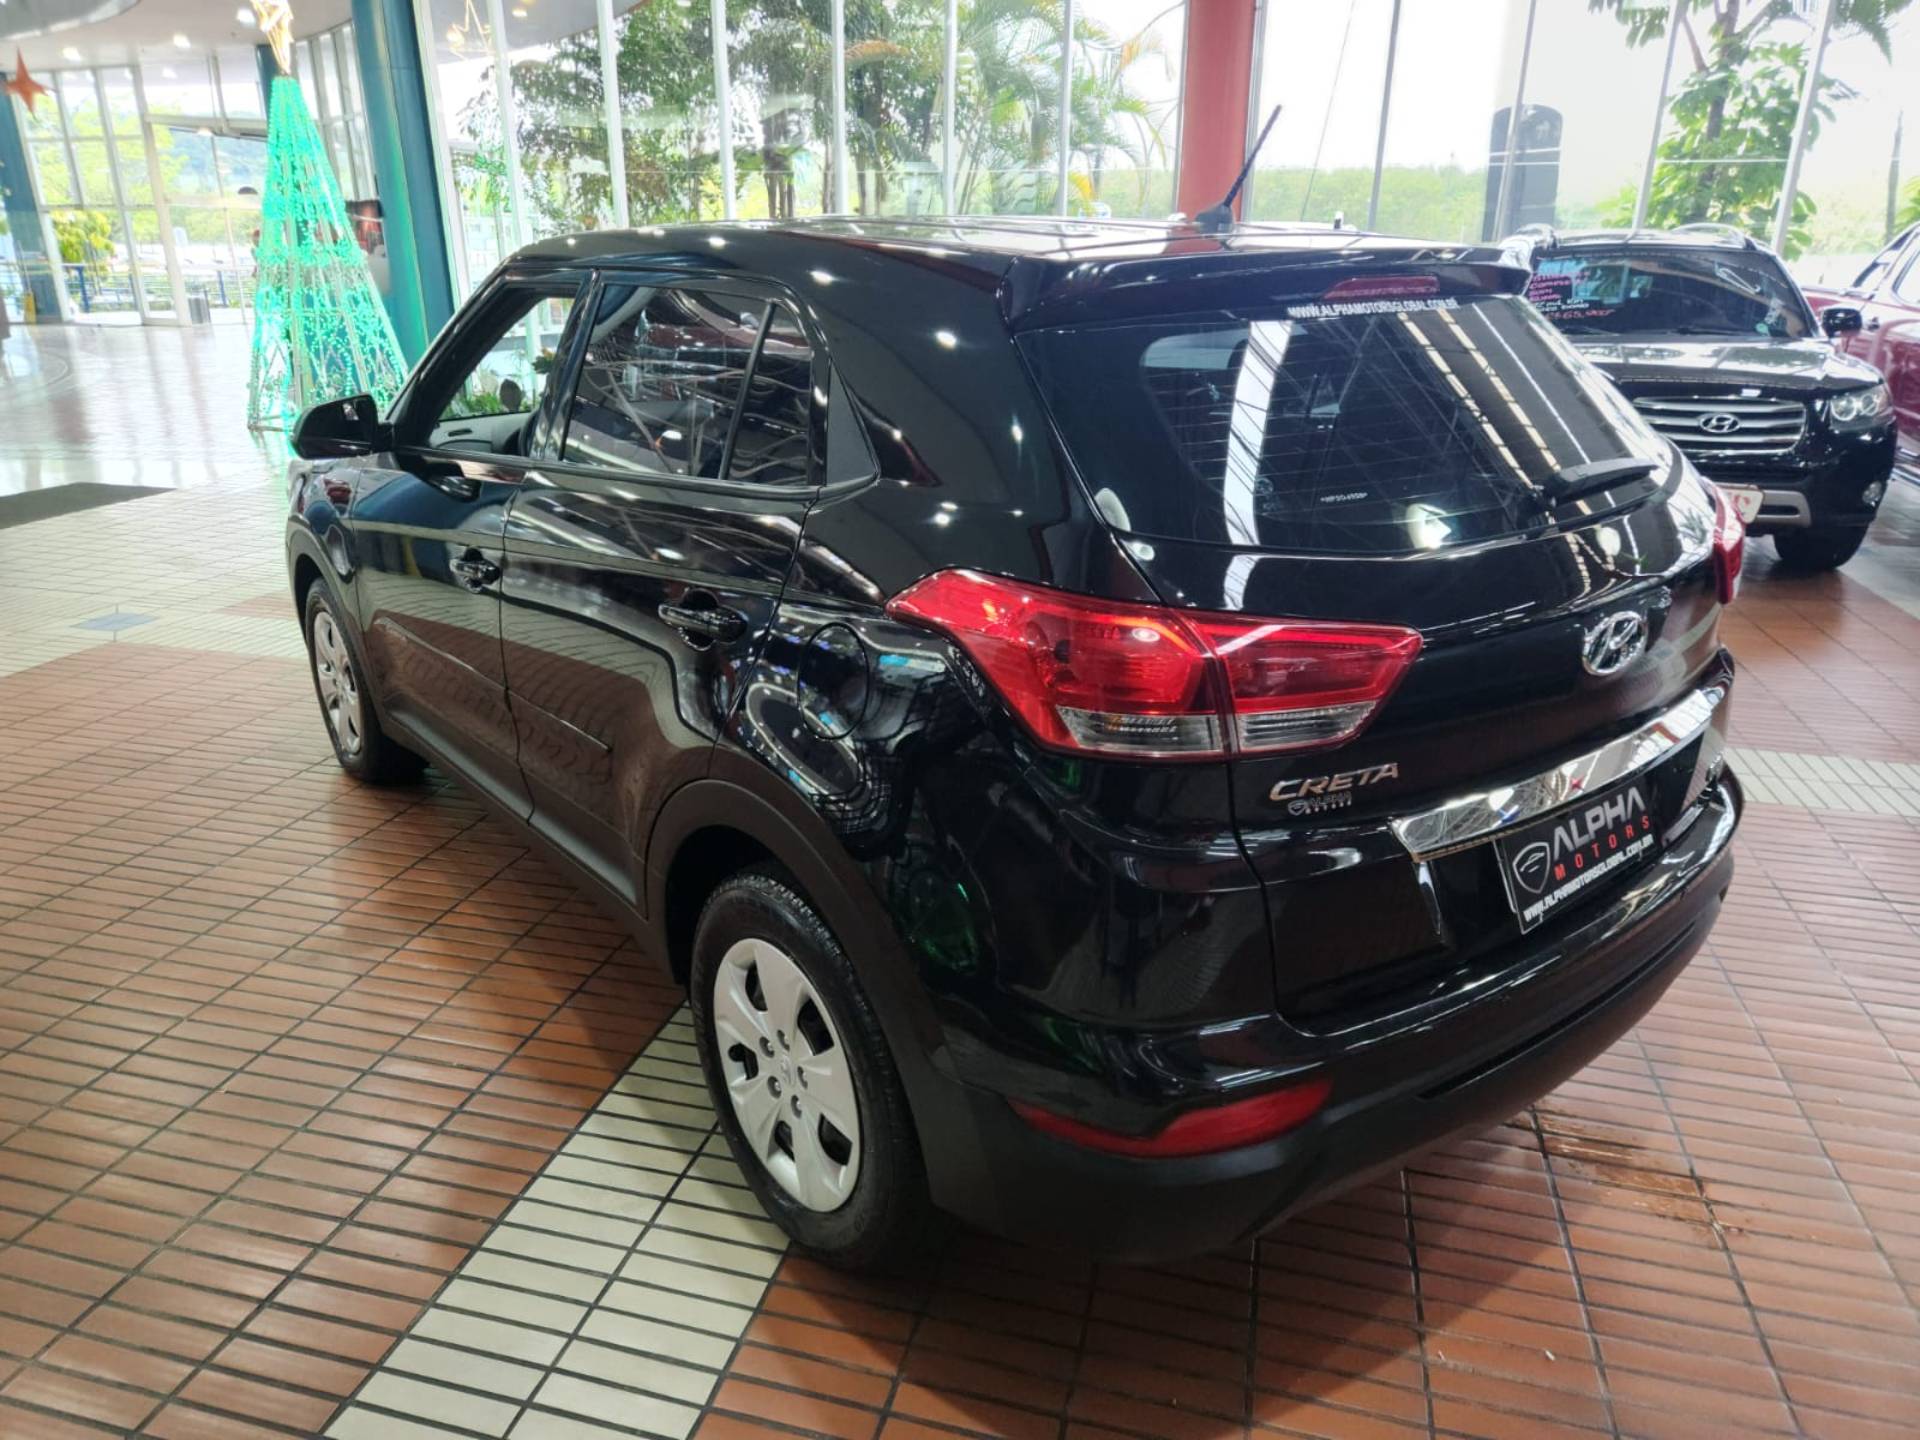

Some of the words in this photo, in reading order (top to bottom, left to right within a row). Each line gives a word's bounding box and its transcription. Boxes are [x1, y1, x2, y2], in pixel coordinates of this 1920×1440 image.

[1269, 763, 1399, 801] CRETA
[1554, 787, 1645, 860] ALPHA
[1555, 815, 1650, 881] MOTORS
